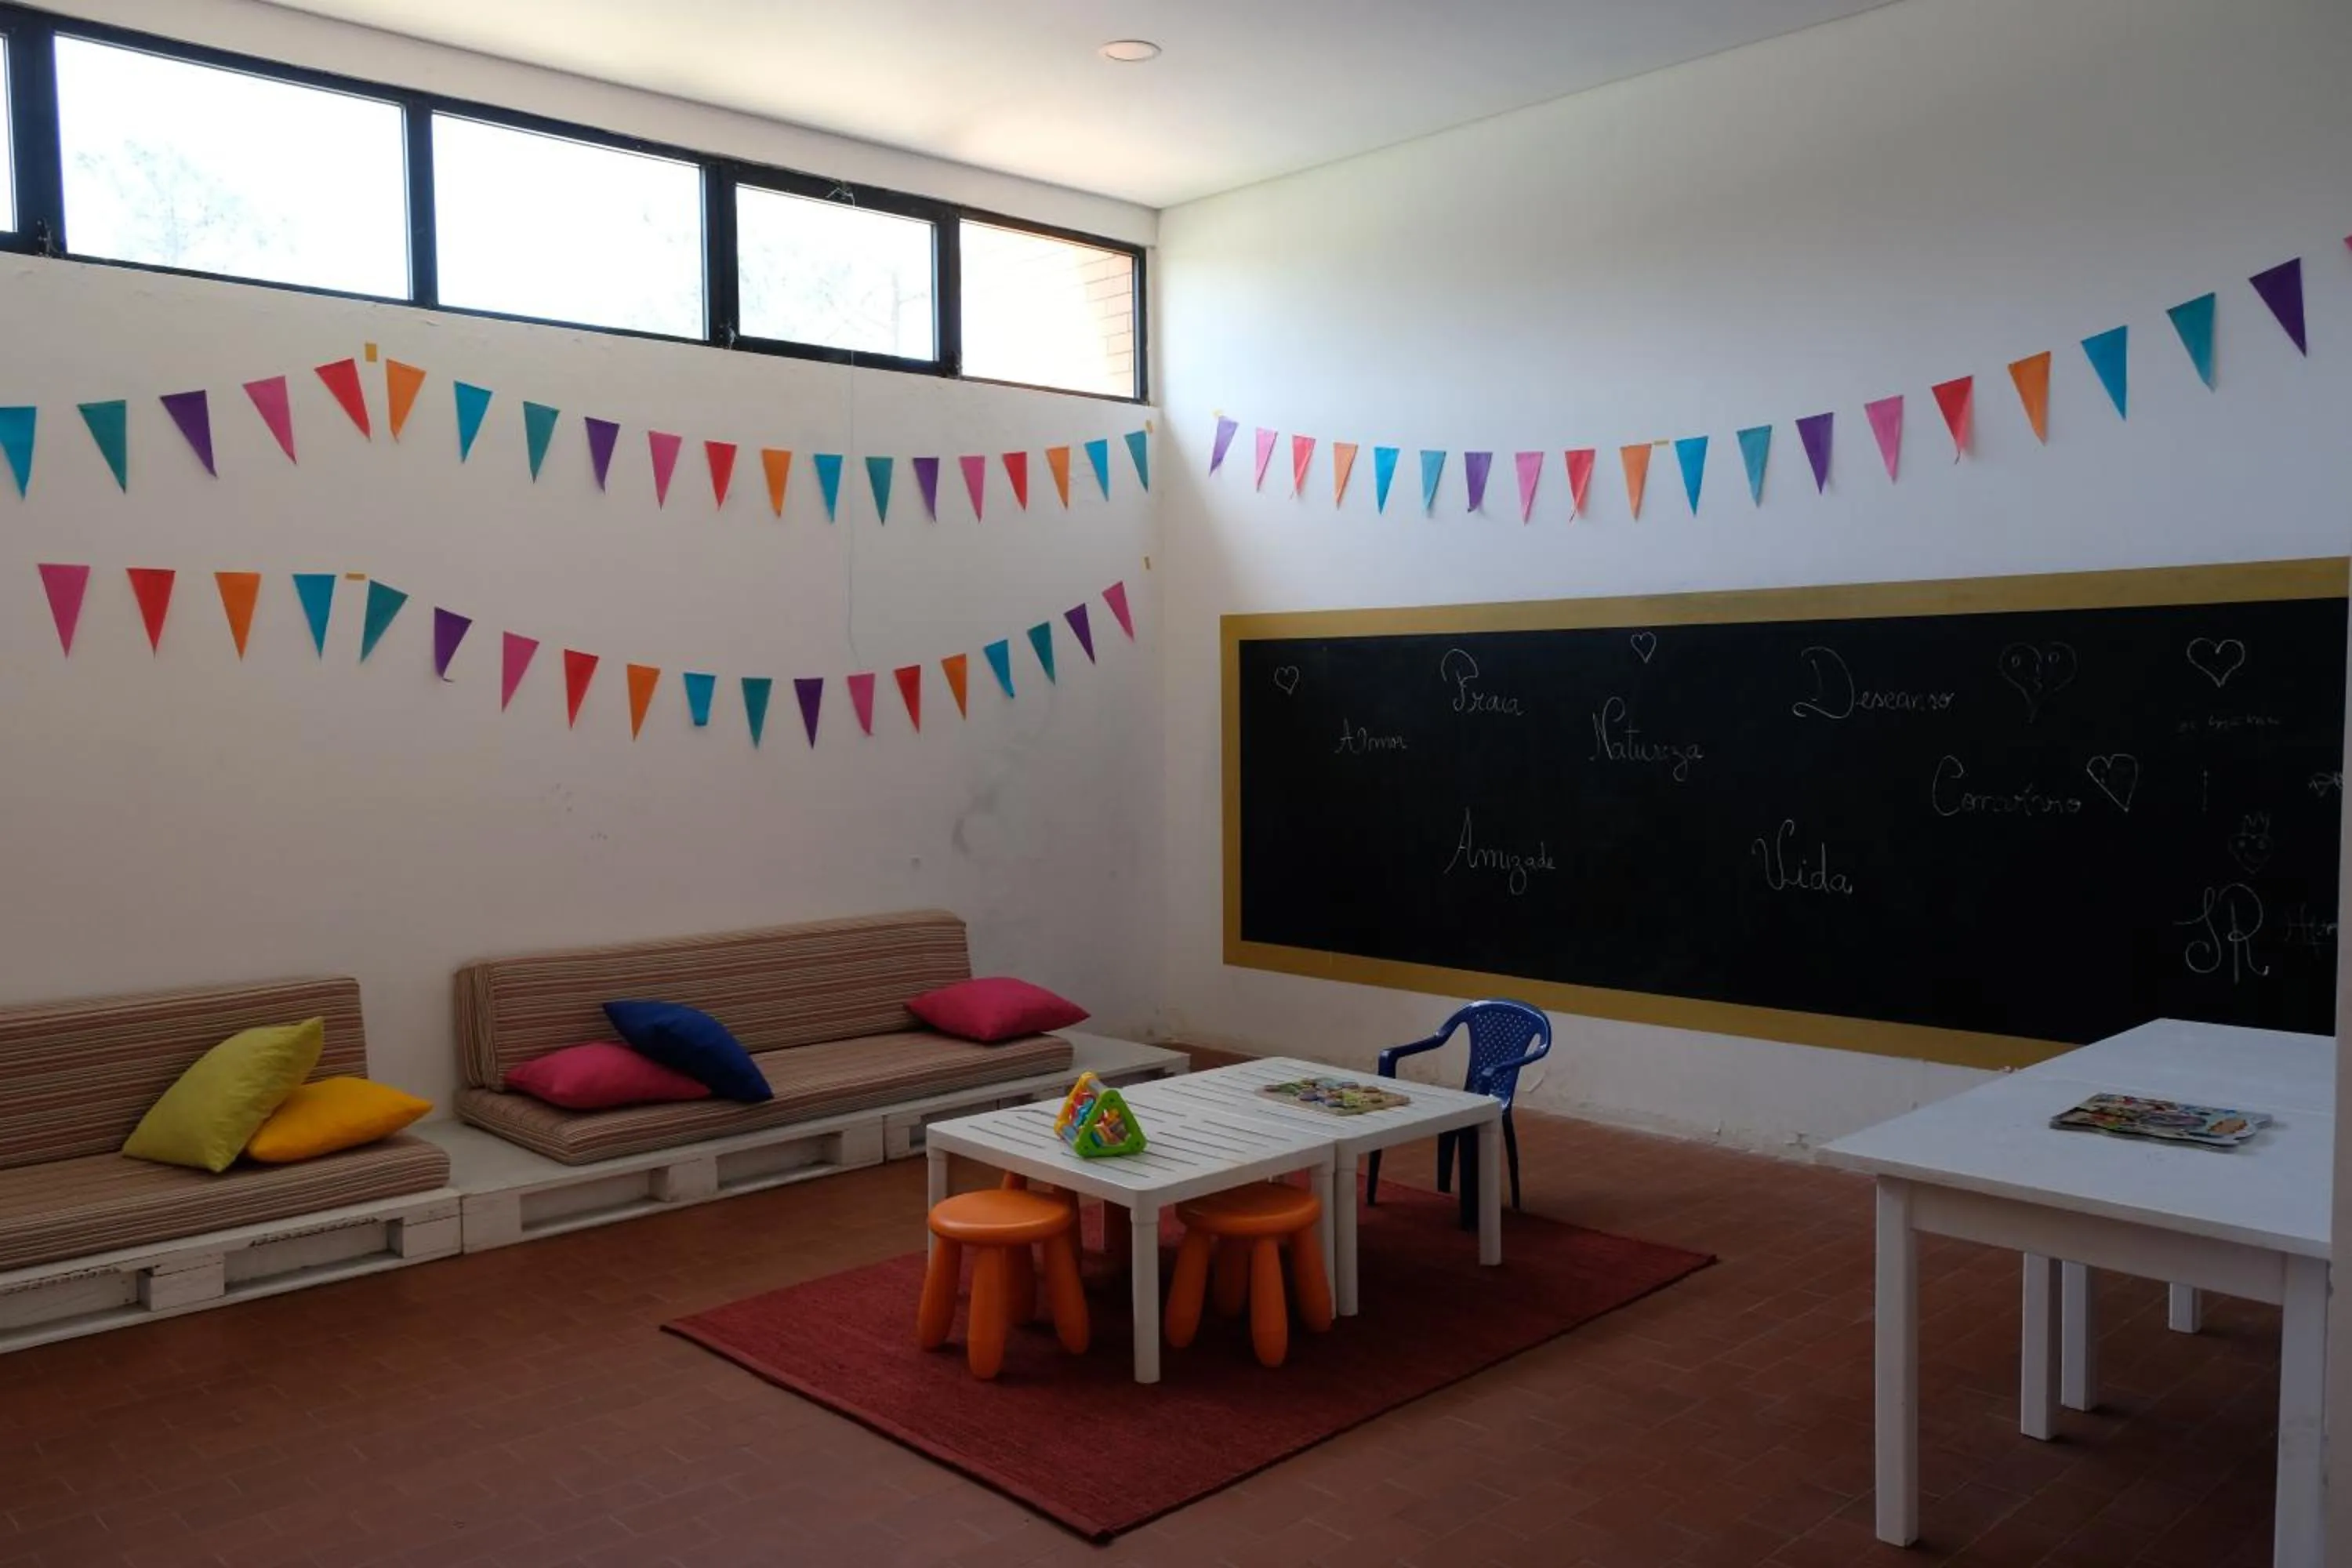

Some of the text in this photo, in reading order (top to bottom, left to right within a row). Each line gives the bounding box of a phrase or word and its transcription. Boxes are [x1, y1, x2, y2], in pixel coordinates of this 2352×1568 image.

[1588, 696, 1704, 782] Natureza
[1443, 806, 1557, 895] Amizade
[1751, 819, 1853, 894] Vida
